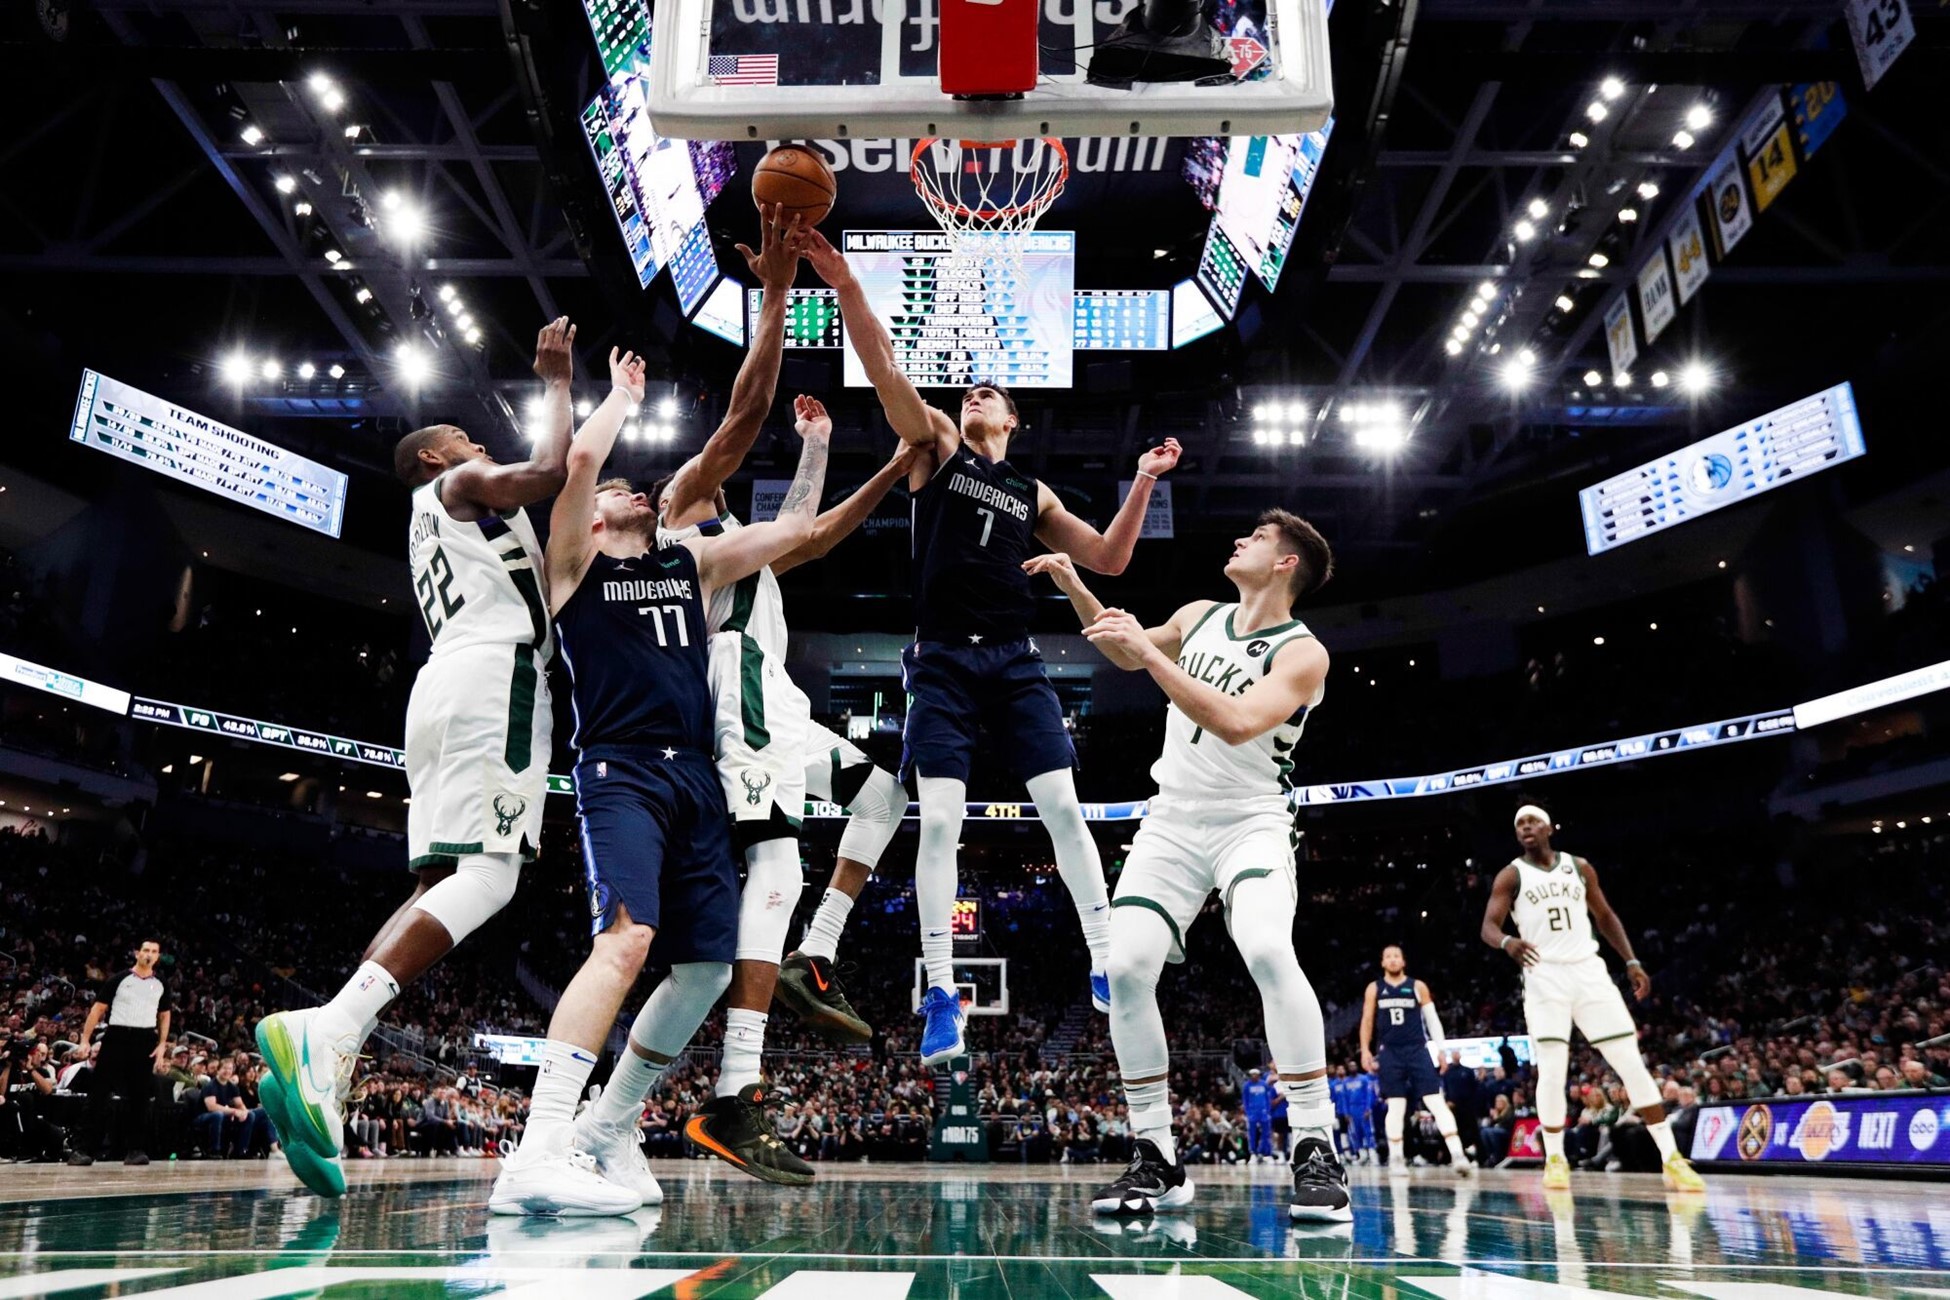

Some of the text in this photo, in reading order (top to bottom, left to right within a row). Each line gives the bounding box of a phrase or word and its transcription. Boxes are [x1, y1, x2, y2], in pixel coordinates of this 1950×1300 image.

[1866, 0, 1901, 47] 43
[1239, 44, 1253, 59] 75
[1755, 137, 1785, 183] 14
[846, 234, 914, 251] MILWAUKEE
[802, 308, 809, 316] 7
[834, 308, 838, 316] 1
[902, 316, 909, 324] 7
[922, 316, 994, 326] TURNOVERS
[802, 318, 809, 326] 2
[832, 318, 840, 326] 3
[786, 328, 840, 336] 11 4 3
[921, 328, 956, 337] TOTAL
[959, 328, 996, 337] FOULS
[784, 338, 797, 346] 22
[817, 338, 824, 346] 2
[834, 338, 838, 346] 1
[916, 340, 1001, 350] BENCH POINTS
[1075, 340, 1086, 348] 77
[950, 375, 966, 384] FT
[167, 407, 280, 460] TEAM SHOOTING
[948, 472, 1030, 522] MAVERICKS
[976, 507, 995, 548] 7
[416, 543, 467, 641] 22
[638, 604, 690, 647] 77
[155, 707, 171, 719] PM
[191, 712, 210, 726] FG
[335, 741, 352, 754] FT
[812, 803, 842, 817] 103
[985, 804, 1021, 818] 4TH
[1525, 882, 1581, 905] BUCKS
[951, 913, 974, 931] 24
[1547, 907, 1572, 931] 21
[1389, 1007, 1405, 1026] 13
[941, 1126, 979, 1144] #NBA75
[1858, 1112, 1899, 1149] NEXT
